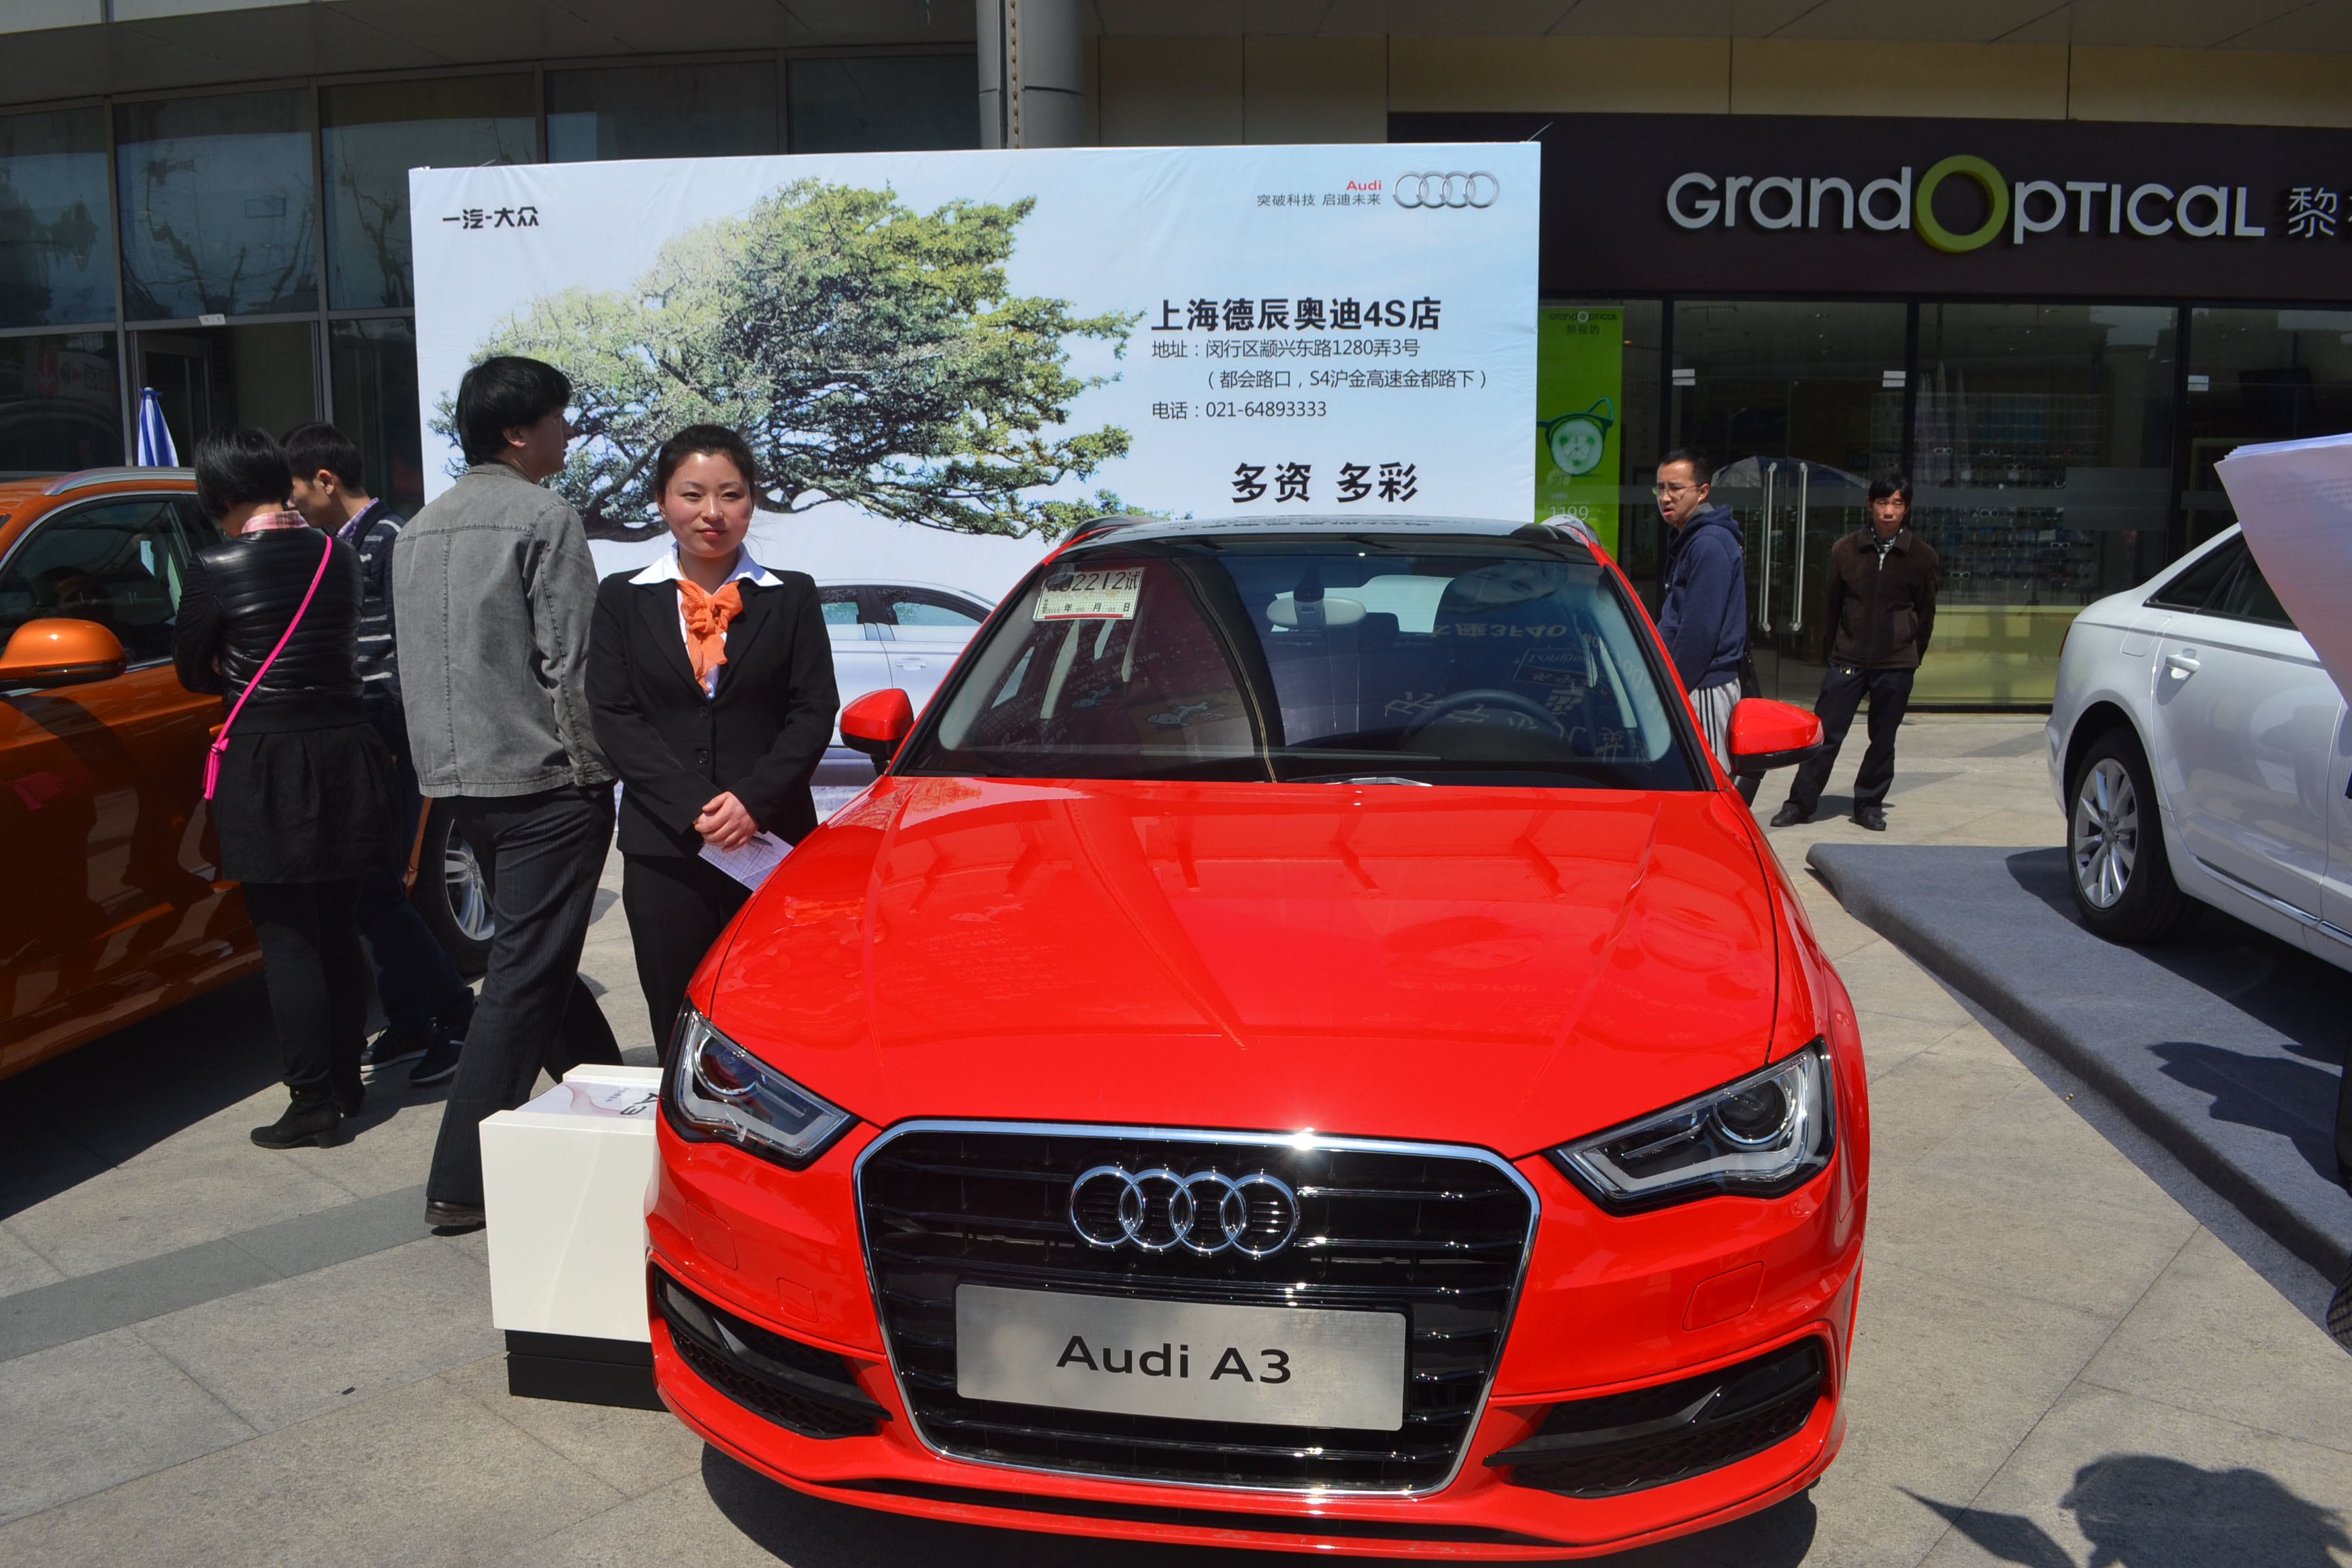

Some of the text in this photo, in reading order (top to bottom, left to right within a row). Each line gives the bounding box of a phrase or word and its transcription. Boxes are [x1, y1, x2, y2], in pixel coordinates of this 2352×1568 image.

[1257, 193, 1381, 207] 突破科技 启迪未来
[1346, 180, 1382, 191] Audi
[442, 206, 539, 229] 一汽-大众
[2288, 187, 2352, 238] 黎
[1151, 297, 1441, 331] 上海德辰奥迪4S店
[1231, 461, 1418, 503] 多资 多彩
[1056, 1335, 1291, 1384] Audi A3
